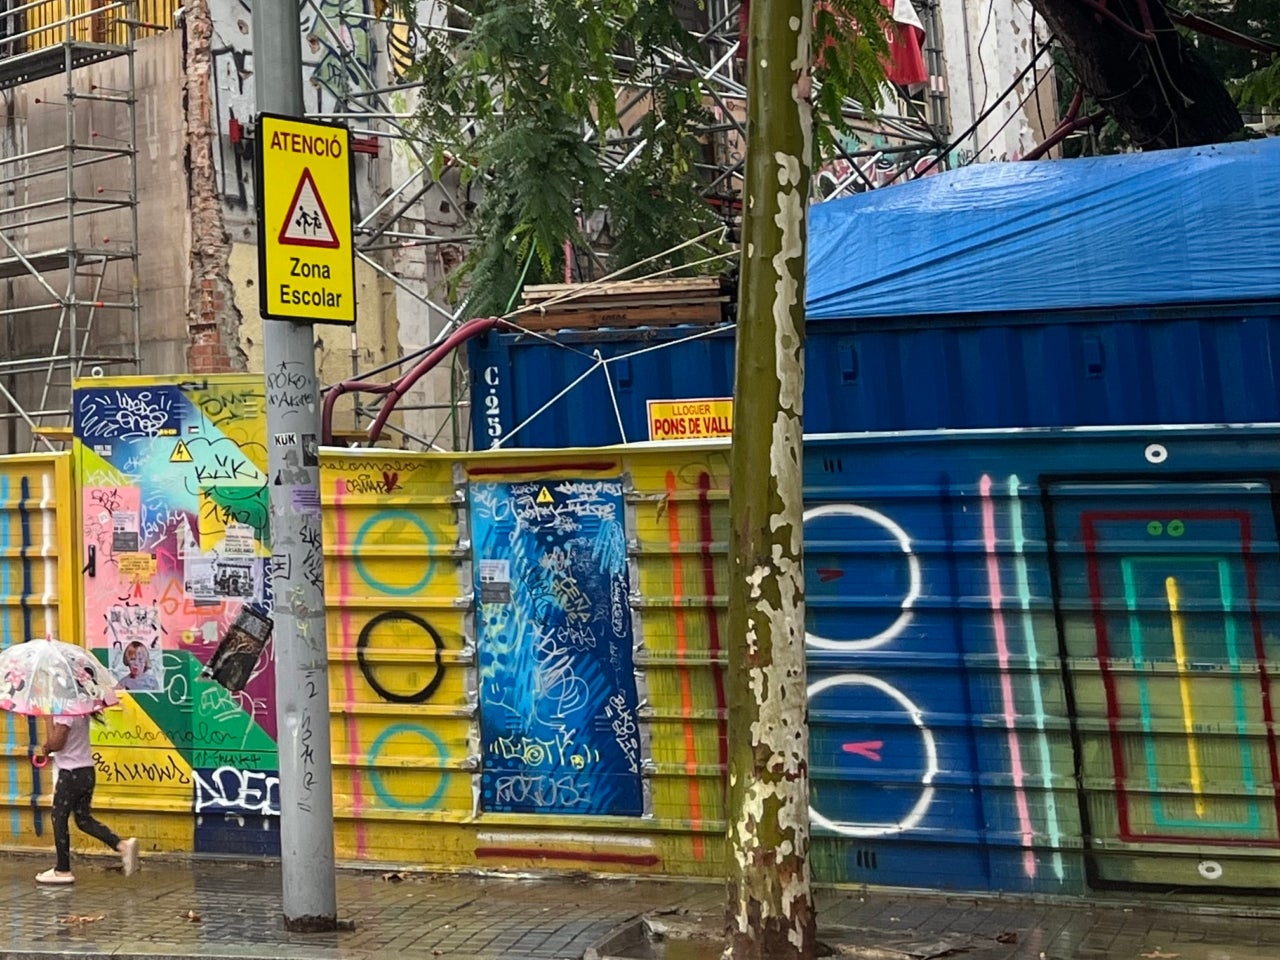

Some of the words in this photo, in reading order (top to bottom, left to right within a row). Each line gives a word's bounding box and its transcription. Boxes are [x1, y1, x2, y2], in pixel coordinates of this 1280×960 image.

[271, 131, 342, 158] ATENCIÓ
[290, 257, 331, 279] Zona
[280, 284, 342, 307] Escolar
[672, 404, 711, 416] LLOGUER
[654, 418, 686, 436] PONS
[688, 417, 701, 434] DE
